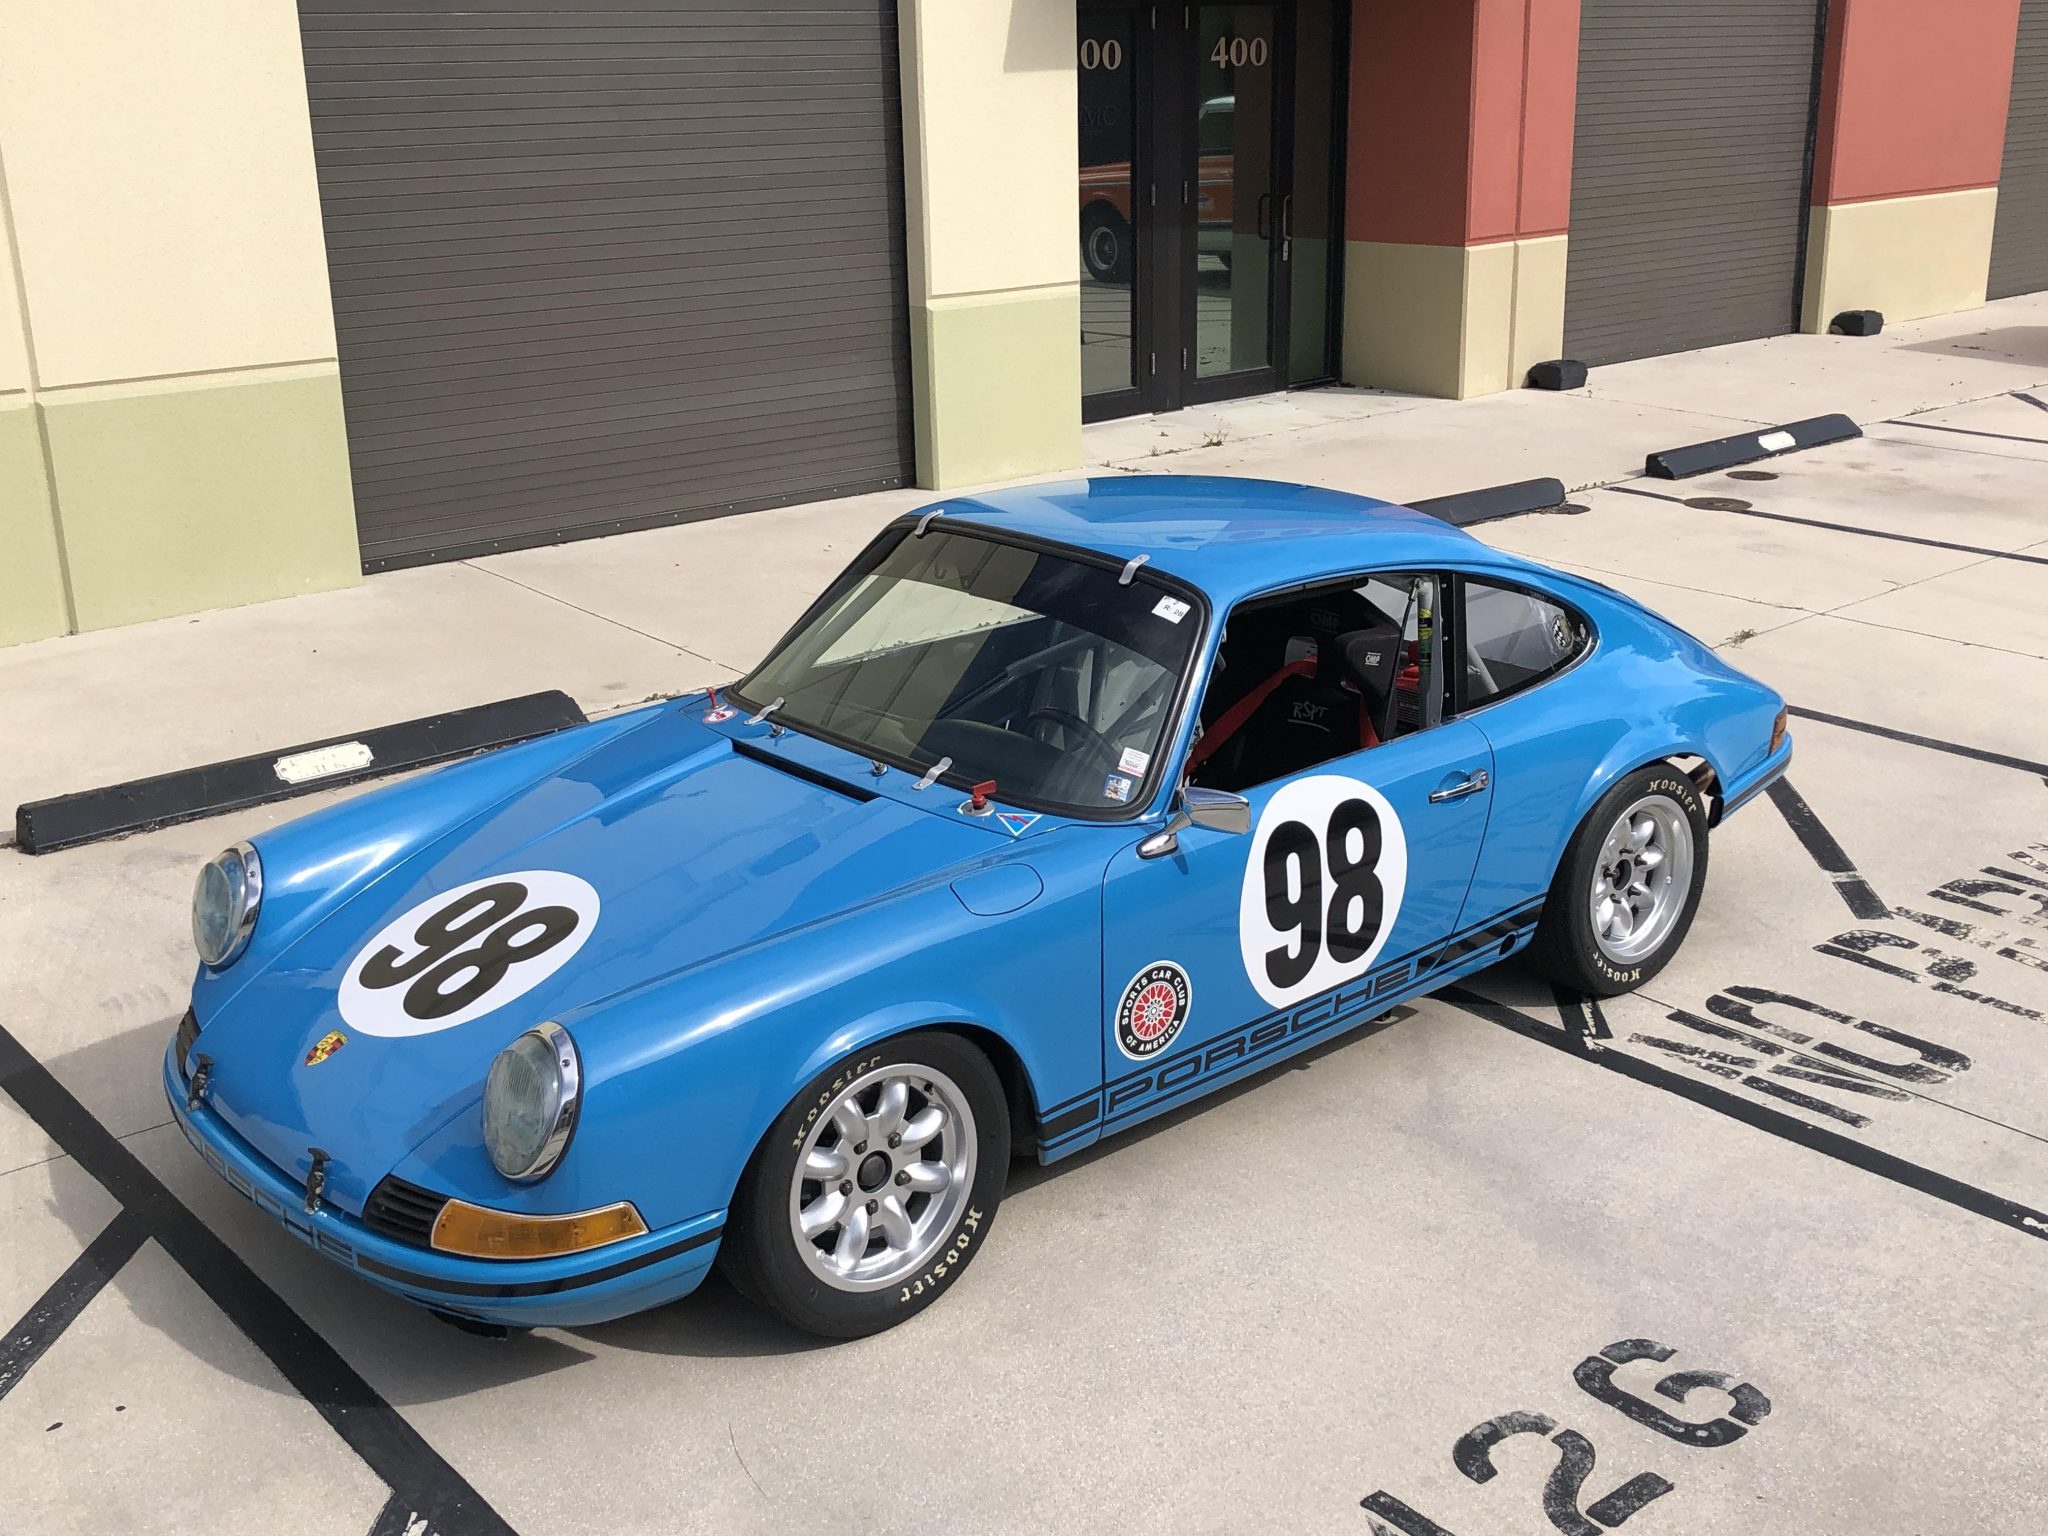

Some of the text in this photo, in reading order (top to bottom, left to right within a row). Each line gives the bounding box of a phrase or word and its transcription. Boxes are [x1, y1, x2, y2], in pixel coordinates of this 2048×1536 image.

[1210, 36, 1268, 69] 400
[1365, 653, 1381, 665] OMP
[1646, 778, 1697, 814] Hoosier
[1263, 797, 1384, 989] 98
[358, 881, 580, 1020] 98
[1592, 951, 1643, 984] Hoosier
[1121, 969, 1187, 1026] SPORTS CAR CLUB
[1125, 1019, 1181, 1053] OF AMERICA
[1108, 962, 1412, 1113] PORSCHE
[1628, 985, 1973, 1129] NO
[791, 1054, 883, 1153] Hoosier
[900, 1203, 984, 1304] Hoosier
